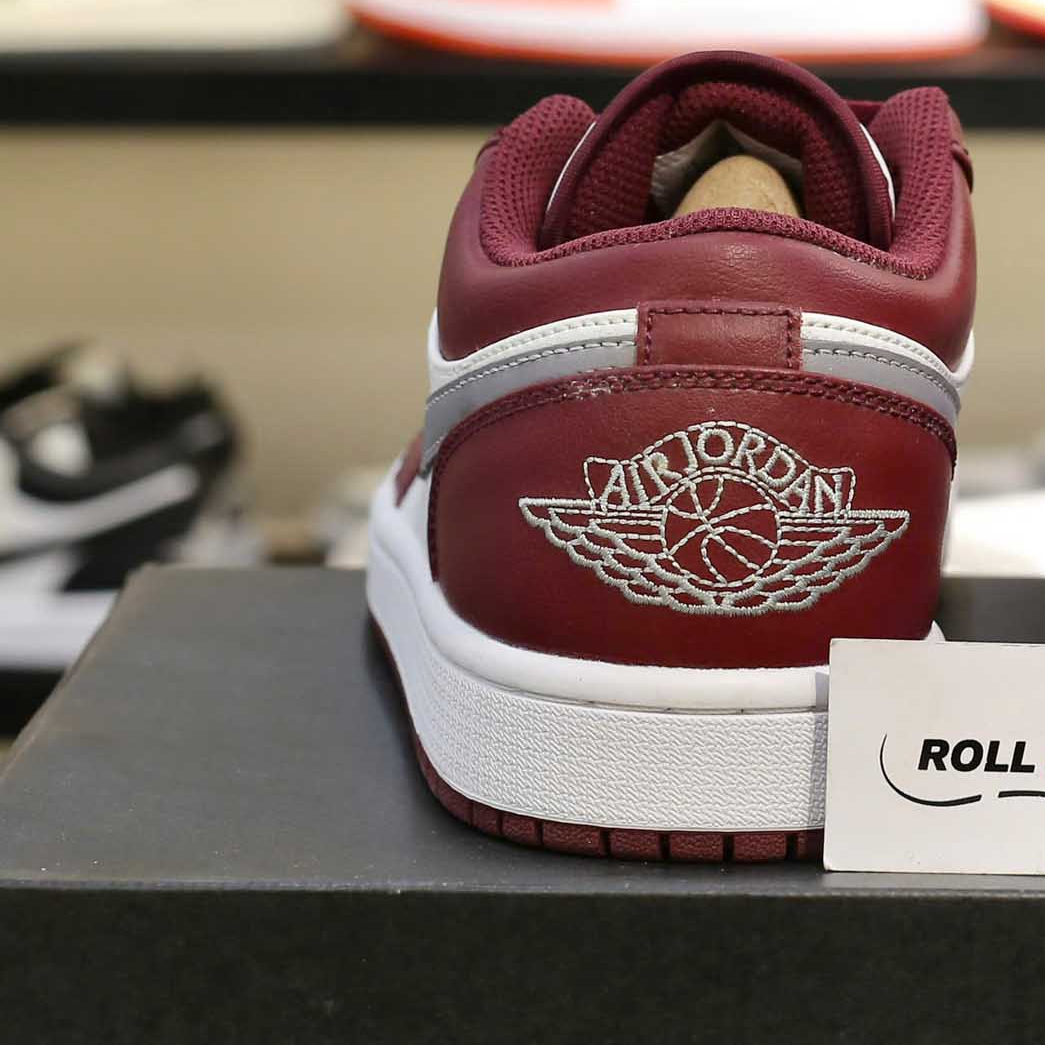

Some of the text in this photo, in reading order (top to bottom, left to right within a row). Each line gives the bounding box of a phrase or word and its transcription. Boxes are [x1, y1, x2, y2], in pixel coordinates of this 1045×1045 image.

[601, 428, 844, 518] AIR JORDAN
[917, 738, 1036, 773] ROLL
